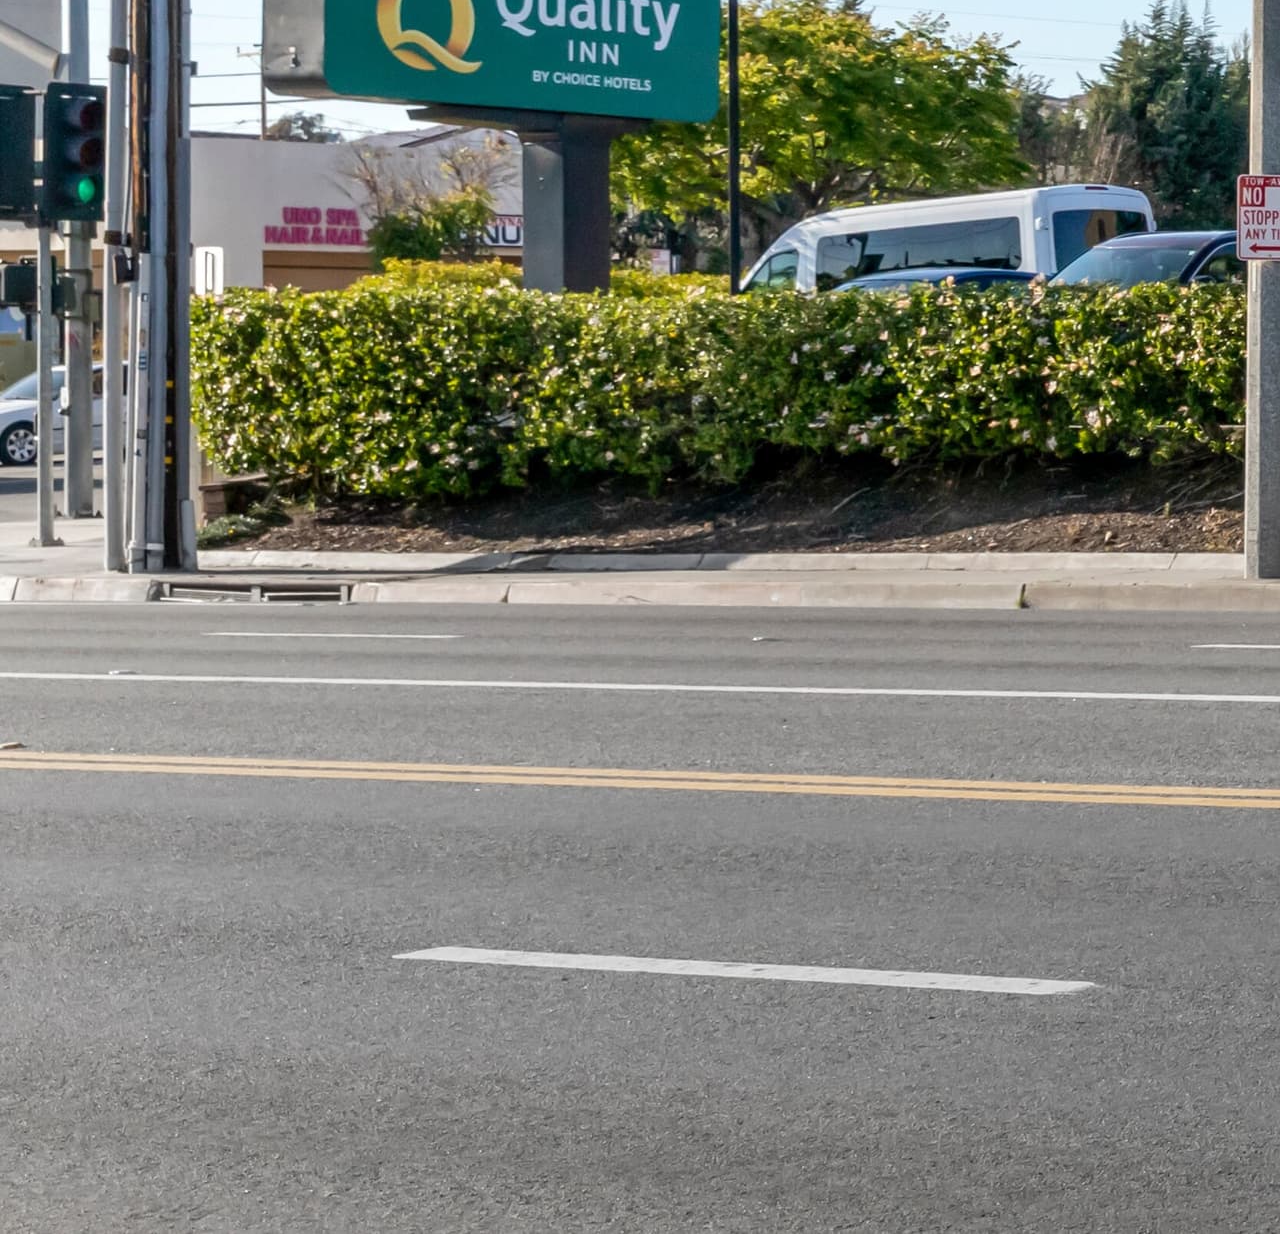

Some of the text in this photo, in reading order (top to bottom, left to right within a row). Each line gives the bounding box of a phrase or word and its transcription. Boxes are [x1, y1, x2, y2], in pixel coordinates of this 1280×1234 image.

[567, 40, 620, 66] INN
[532, 70, 652, 92] BY CHOICE HOTELS
[1242, 187, 1263, 206] NO
[282, 206, 360, 227] UNO SPA
[1245, 228, 1267, 240] ANY
